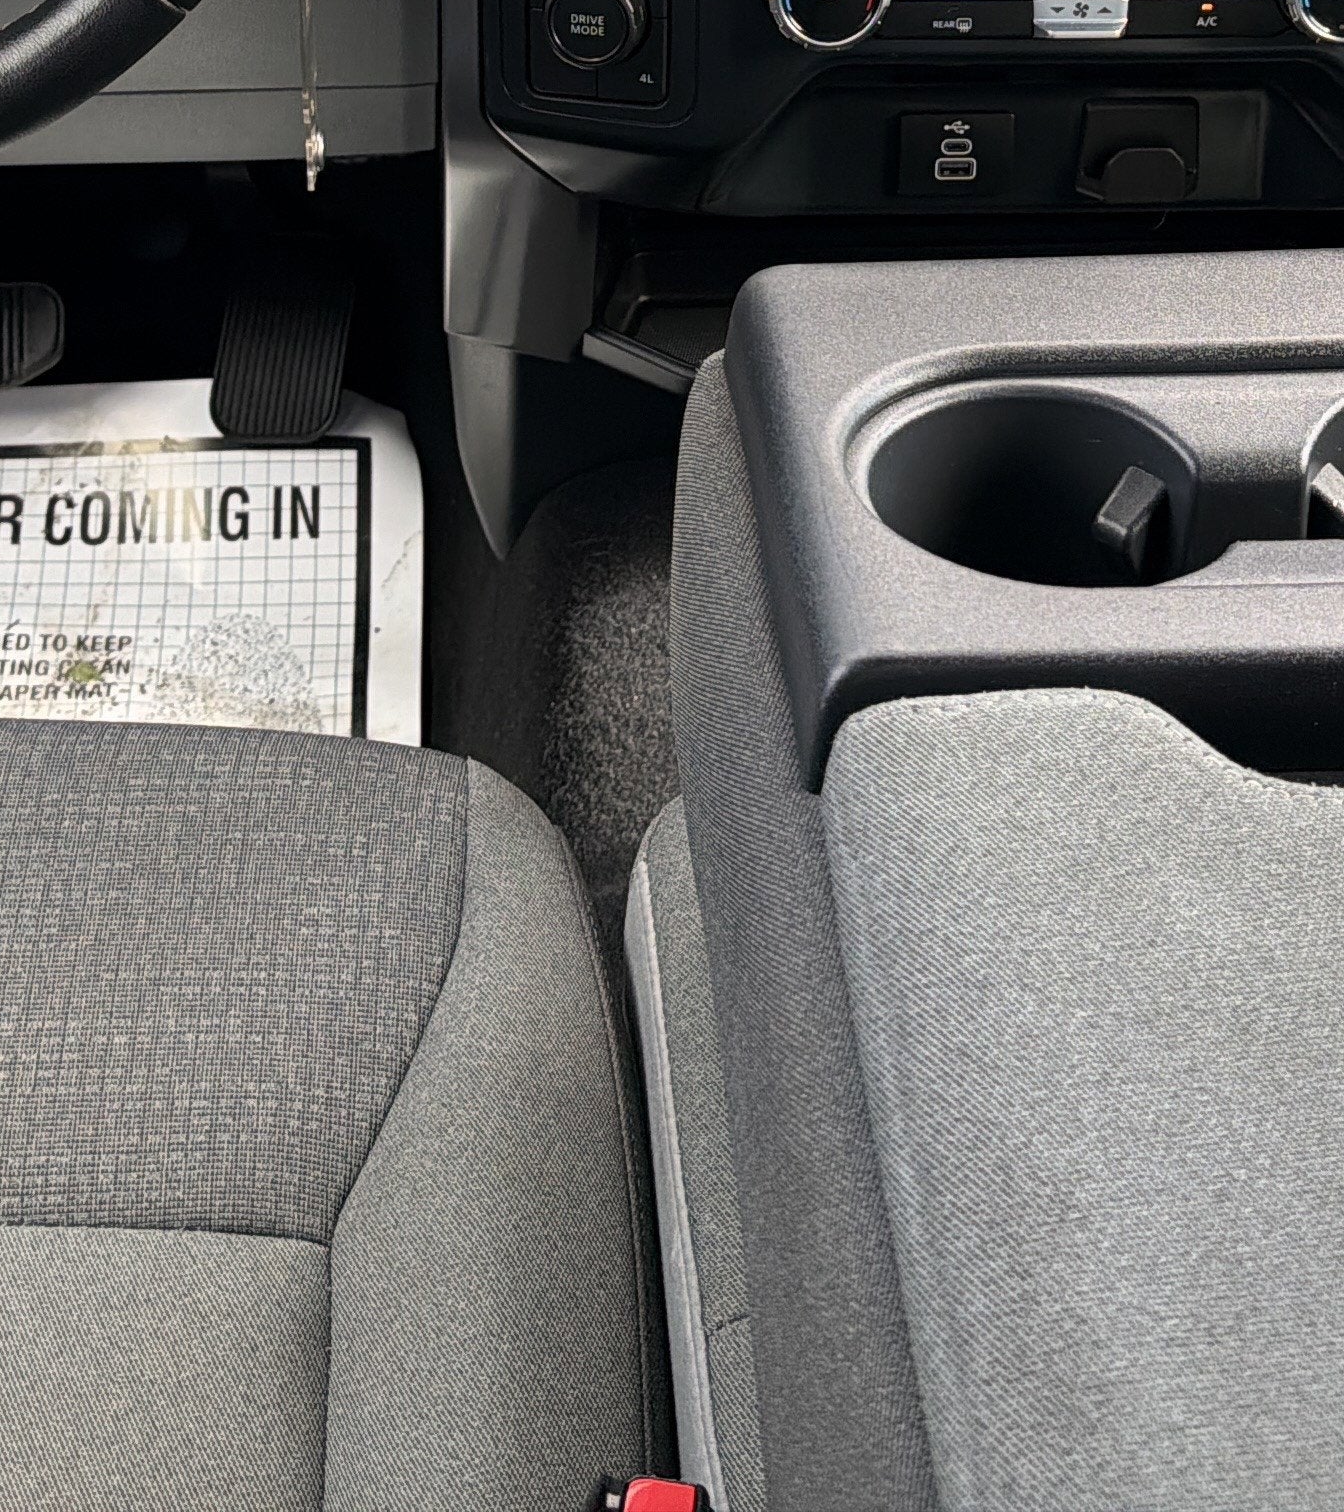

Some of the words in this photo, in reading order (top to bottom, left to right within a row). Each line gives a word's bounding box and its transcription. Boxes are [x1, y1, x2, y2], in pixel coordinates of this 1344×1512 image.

[570, 13, 605, 25] DRIVE
[933, 20, 955, 29] REAR
[1197, 16, 1218, 28] A/C
[570, 24, 606, 36] MODE
[639, 73, 655, 84] 4L
[44, 486, 250, 546] COMING
[272, 485, 320, 540] IN
[38, 633, 67, 651] TO
[75, 634, 133, 652] KEEP
